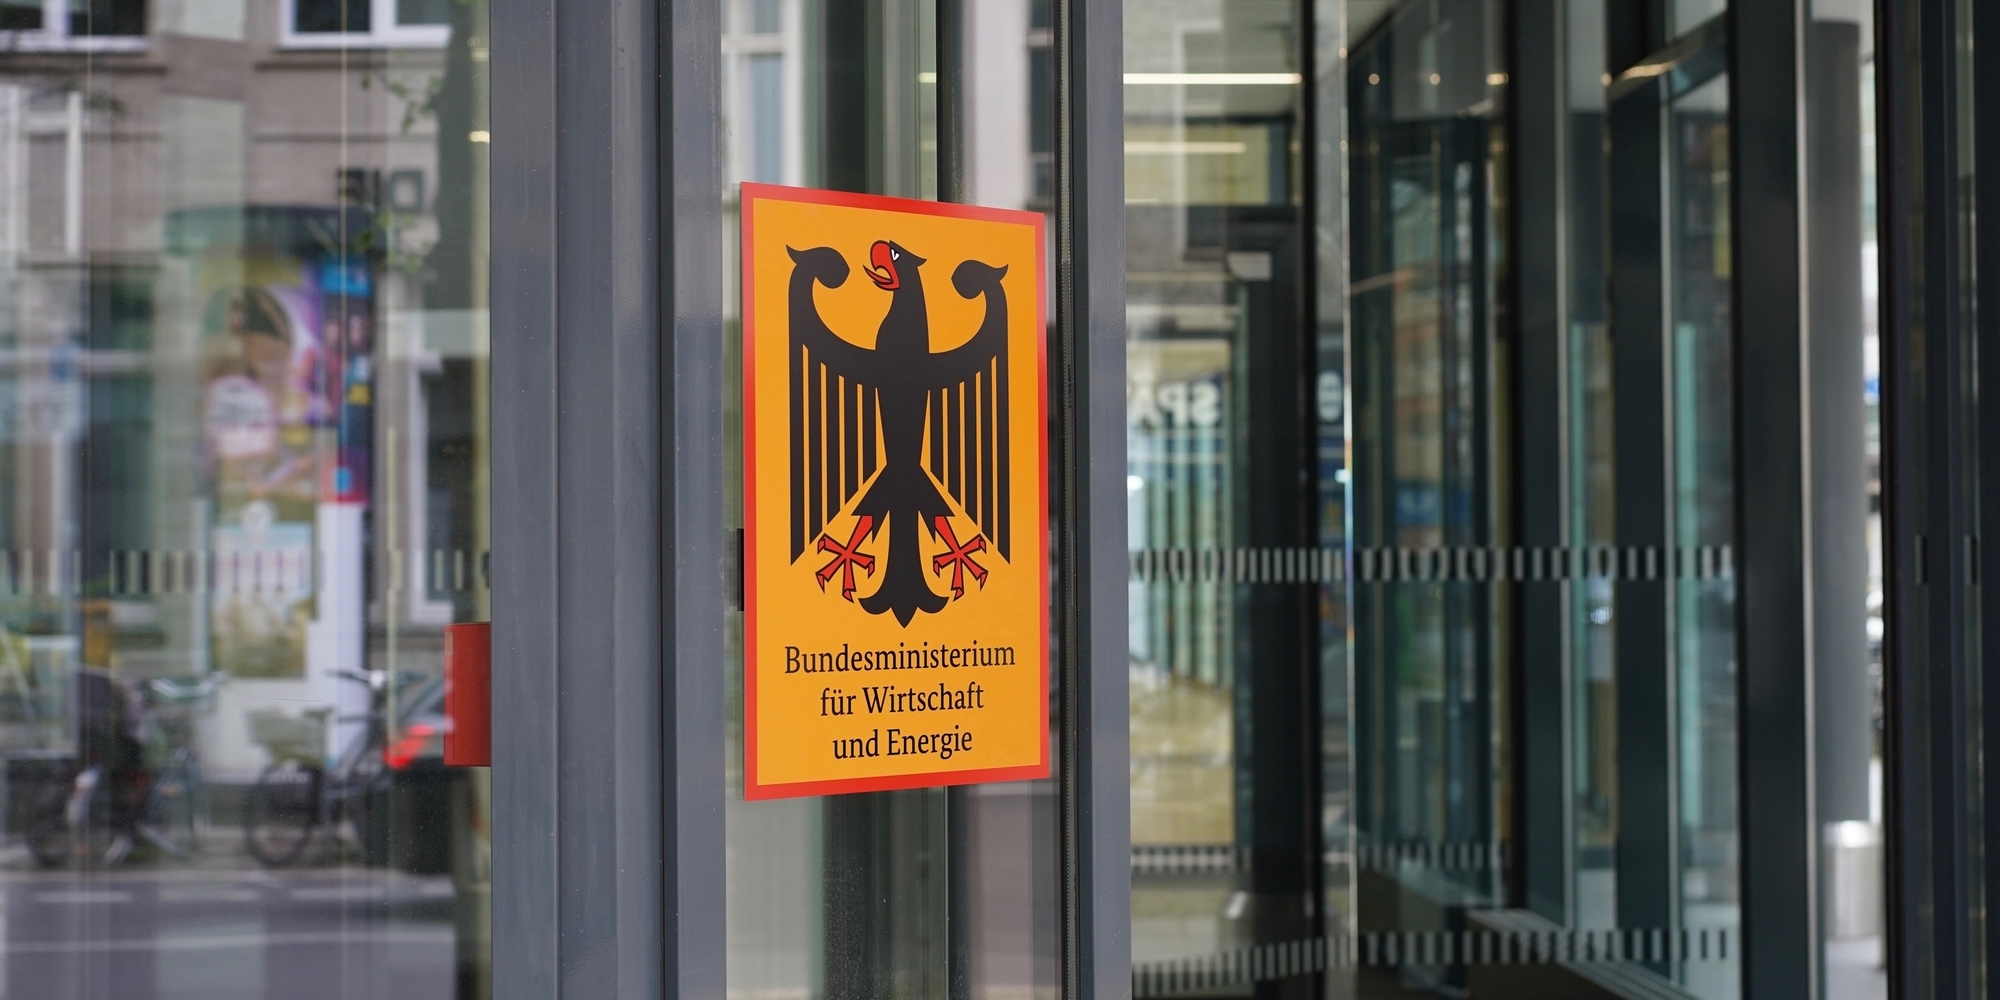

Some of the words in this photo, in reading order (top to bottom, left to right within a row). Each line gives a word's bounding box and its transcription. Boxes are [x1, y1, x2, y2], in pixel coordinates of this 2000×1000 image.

[784, 639, 1016, 674] Bundesministerium
[820, 687, 857, 716] für
[862, 681, 984, 714] Wirtschaft
[832, 728, 879, 760] und
[886, 724, 973, 760] Energie
